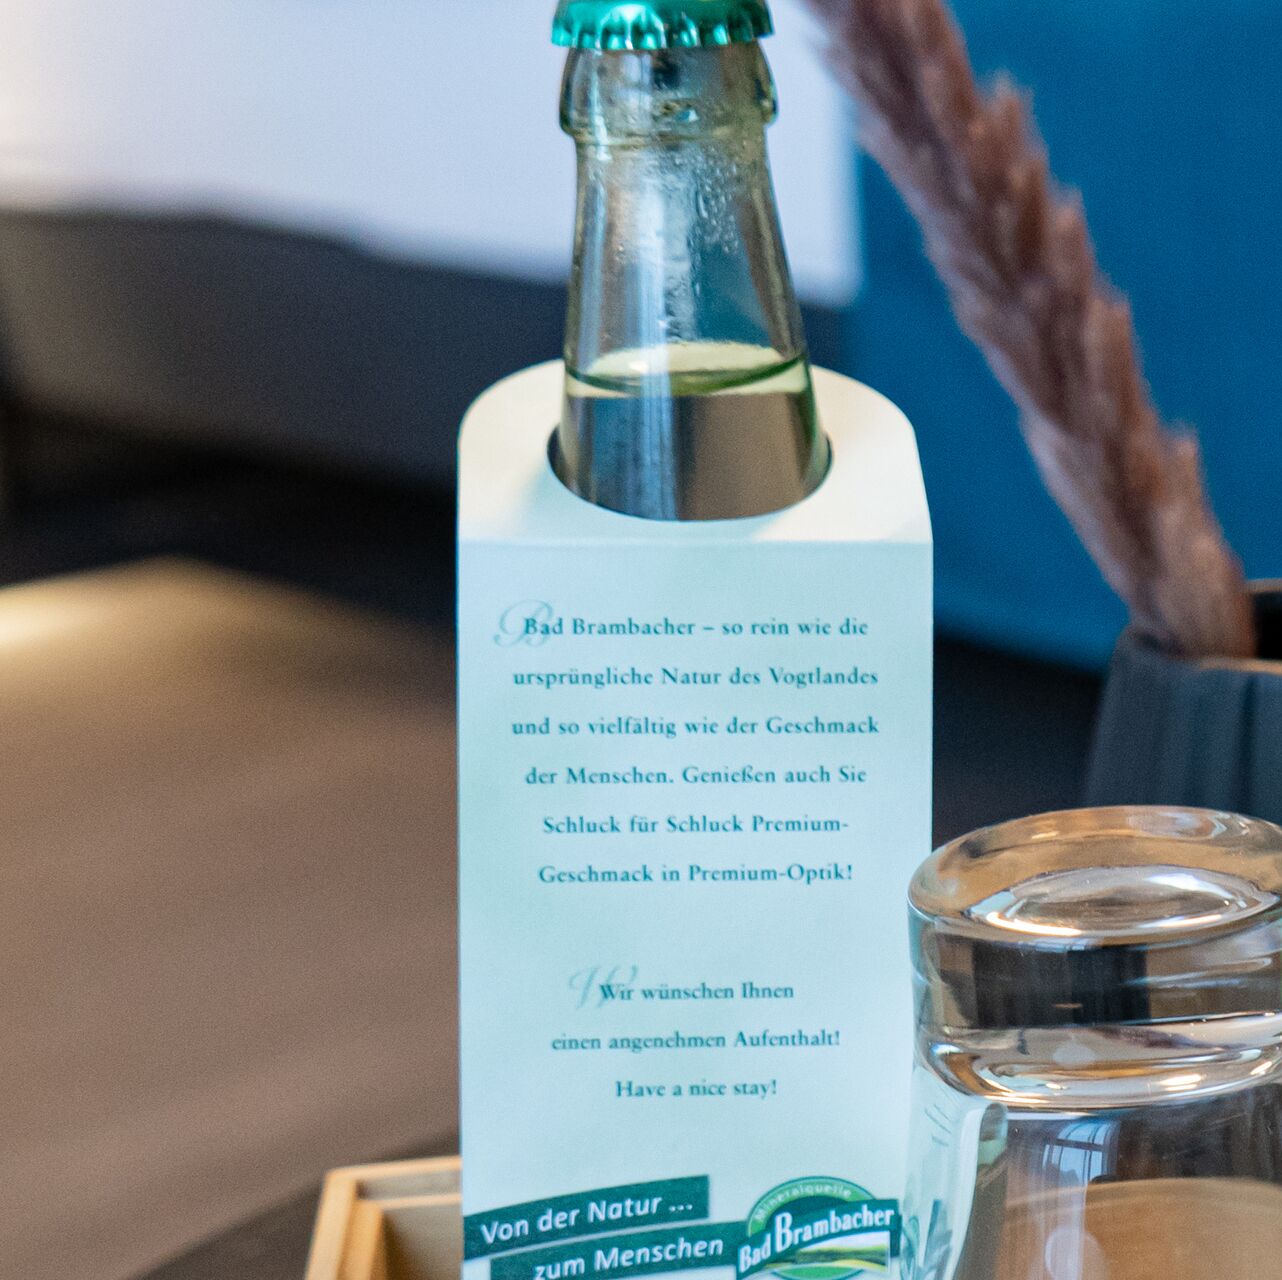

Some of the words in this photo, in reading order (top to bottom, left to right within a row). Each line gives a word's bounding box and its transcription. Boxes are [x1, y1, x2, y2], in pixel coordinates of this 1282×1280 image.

[571, 616, 697, 637] Brambacher
[721, 622, 744, 636] so
[750, 617, 790, 637] rein
[796, 617, 832, 637] wie
[837, 616, 869, 637] die
[512, 665, 654, 691] ursprüngliche
[660, 666, 722, 686] Natur
[727, 665, 762, 686] des
[768, 665, 879, 690] Vogtlandes
[511, 716, 551, 736] und
[557, 721, 581, 736] so
[586, 715, 678, 740] vielfältig
[683, 715, 720, 736] wie
[725, 715, 759, 735] der
[764, 714, 880, 735] Geschmack
[523, 766, 559, 786] der
[565, 765, 676, 785] Menschen.
[681, 764, 777, 785] Genießen
[783, 764, 832, 785] auch
[837, 764, 867, 784] Sie
[542, 815, 622, 835] Schluck
[628, 814, 660, 834] für
[665, 813, 744, 834] Schluck
[751, 813, 849, 833] Premium-
[536, 863, 655, 884] Geschmack
[660, 864, 681, 883] in
[687, 862, 854, 886] Premium-Optik!
[639, 981, 735, 1001] wünschen
[740, 980, 795, 1000] Ihnen
[550, 1031, 602, 1052] einen
[607, 1029, 727, 1055] angenehmen
[733, 1027, 841, 1049] Aufenthalt!
[614, 1079, 666, 1099] Have
[671, 1084, 684, 1098] a
[687, 1078, 728, 1098] nice
[731, 1078, 778, 1100] stay!
[480, 1218, 530, 1245] Von
[536, 1208, 580, 1233] der
[586, 1195, 663, 1224] Natur
[738, 1232, 772, 1274] Bad
[774, 1204, 895, 1253] Brambacher
[592, 1236, 725, 1271] Menschen
